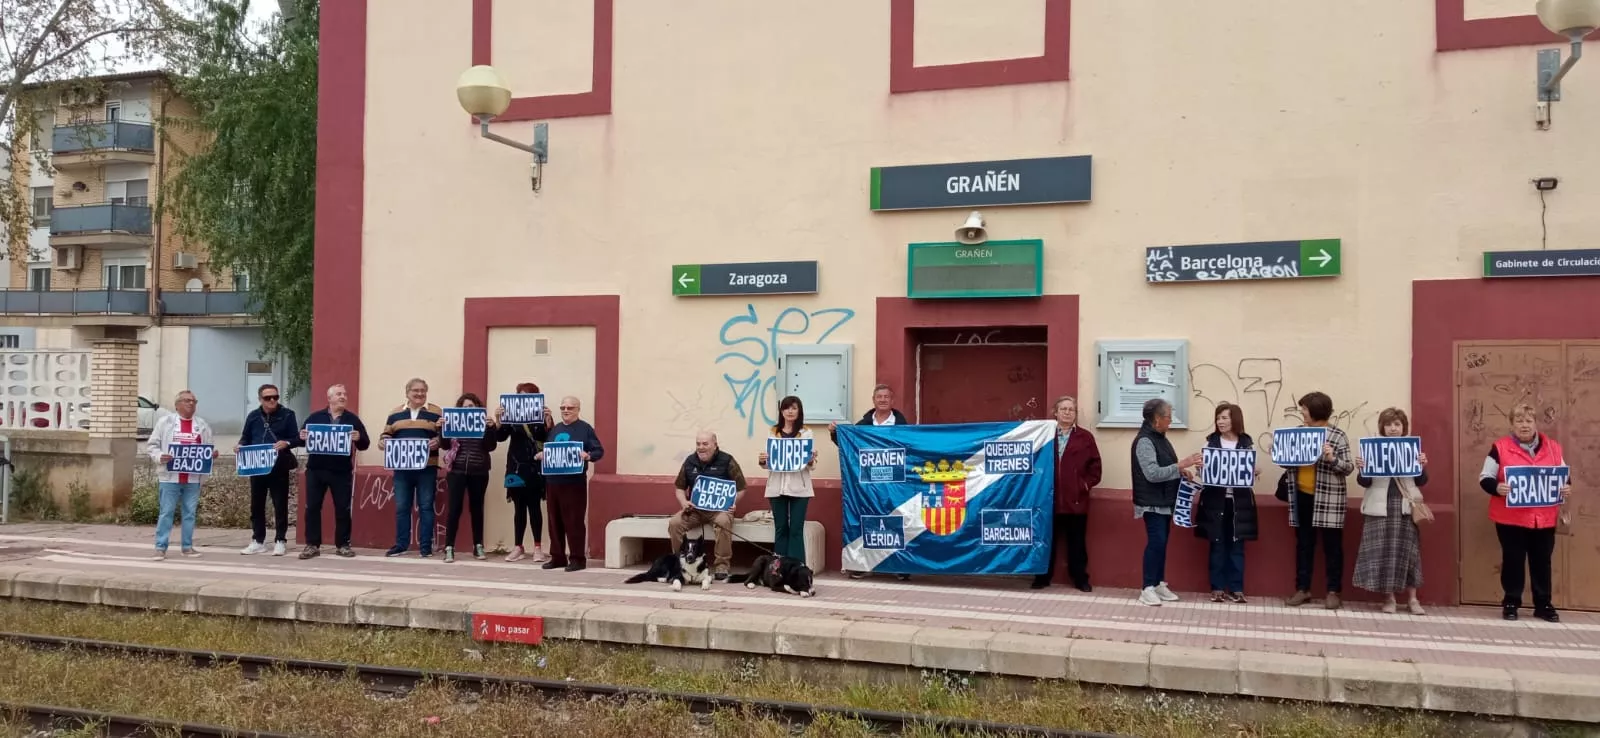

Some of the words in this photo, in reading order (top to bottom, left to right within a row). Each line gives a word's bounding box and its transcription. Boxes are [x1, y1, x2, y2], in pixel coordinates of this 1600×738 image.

[946, 170, 1020, 194] GRAÑÉN
[1181, 254, 1263, 270] Barcelona
[1495, 259, 1539, 268] Gabinete
[1541, 258, 1554, 267] de
[729, 272, 788, 287] Zaragoza
[443, 411, 486, 434] PIRACES
[168, 446, 213, 460] ALBERO
[385, 440, 429, 468] ROBRES
[770, 439, 810, 471] CURBE
[986, 442, 1031, 457] QUEREMOS
[1272, 432, 1325, 462] SANGARREN
[173, 459, 203, 471] BAJO
[543, 446, 583, 469] TRAMACED
[987, 458, 1030, 472] TRENES
[1360, 442, 1422, 474] VALFONDA
[1202, 449, 1254, 486] ROBRES
[693, 478, 736, 498] ALBERO
[698, 493, 726, 509] BAJO
[879, 518, 886, 531] A
[1003, 513, 1010, 525] Y
[984, 527, 1031, 541] BARCELONA
[494, 624, 506, 633] No
[507, 626, 530, 635] pasar
